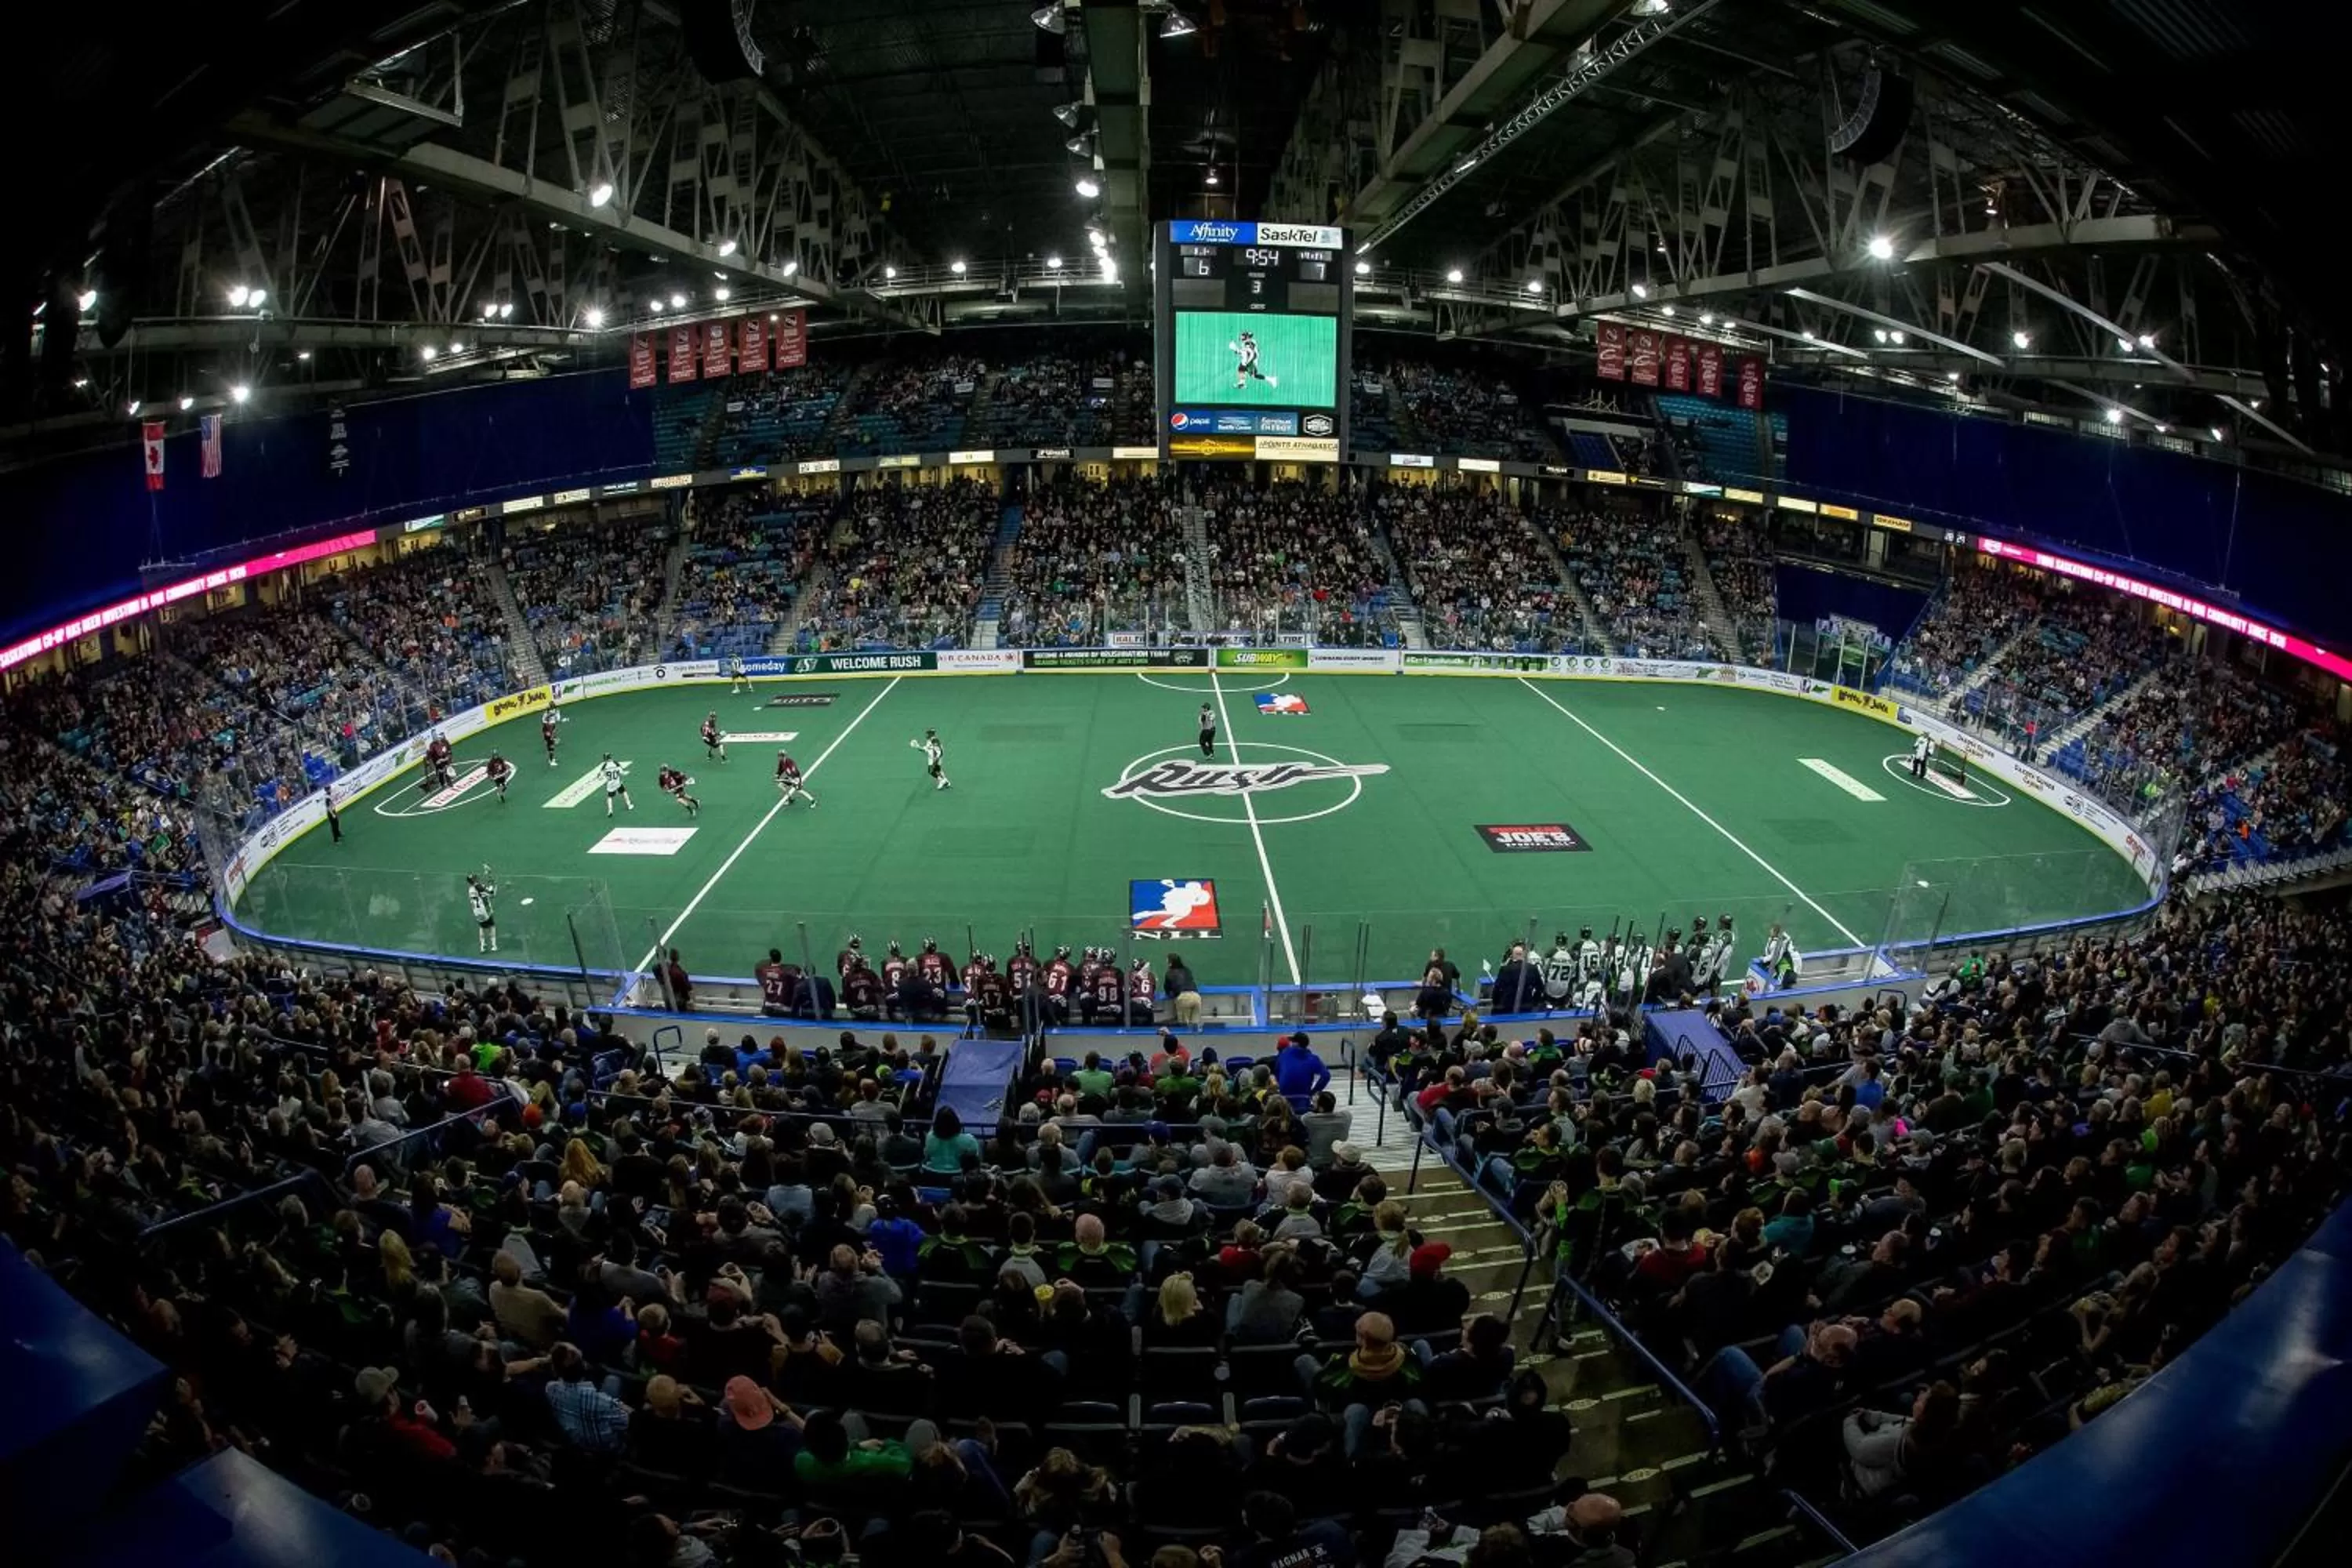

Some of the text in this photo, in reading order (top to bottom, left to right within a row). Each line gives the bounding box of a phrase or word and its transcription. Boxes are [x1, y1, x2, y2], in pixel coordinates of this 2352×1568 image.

[1189, 222, 1239, 241] Affinity
[1261, 227, 1318, 242] SaskTel
[1246, 249, 1279, 267] 9:54
[1316, 263, 1326, 280] 7
[1252, 280, 1261, 294] 3
[830, 655, 921, 670] WELCOME RUSH
[1233, 653, 1283, 664] SUBWAY
[1132, 931, 1221, 940] NLL
[1550, 964, 1570, 980] 72
[766, 979, 783, 996] 27
[1048, 973, 1067, 991] 61
[982, 992, 1003, 1006] 17
